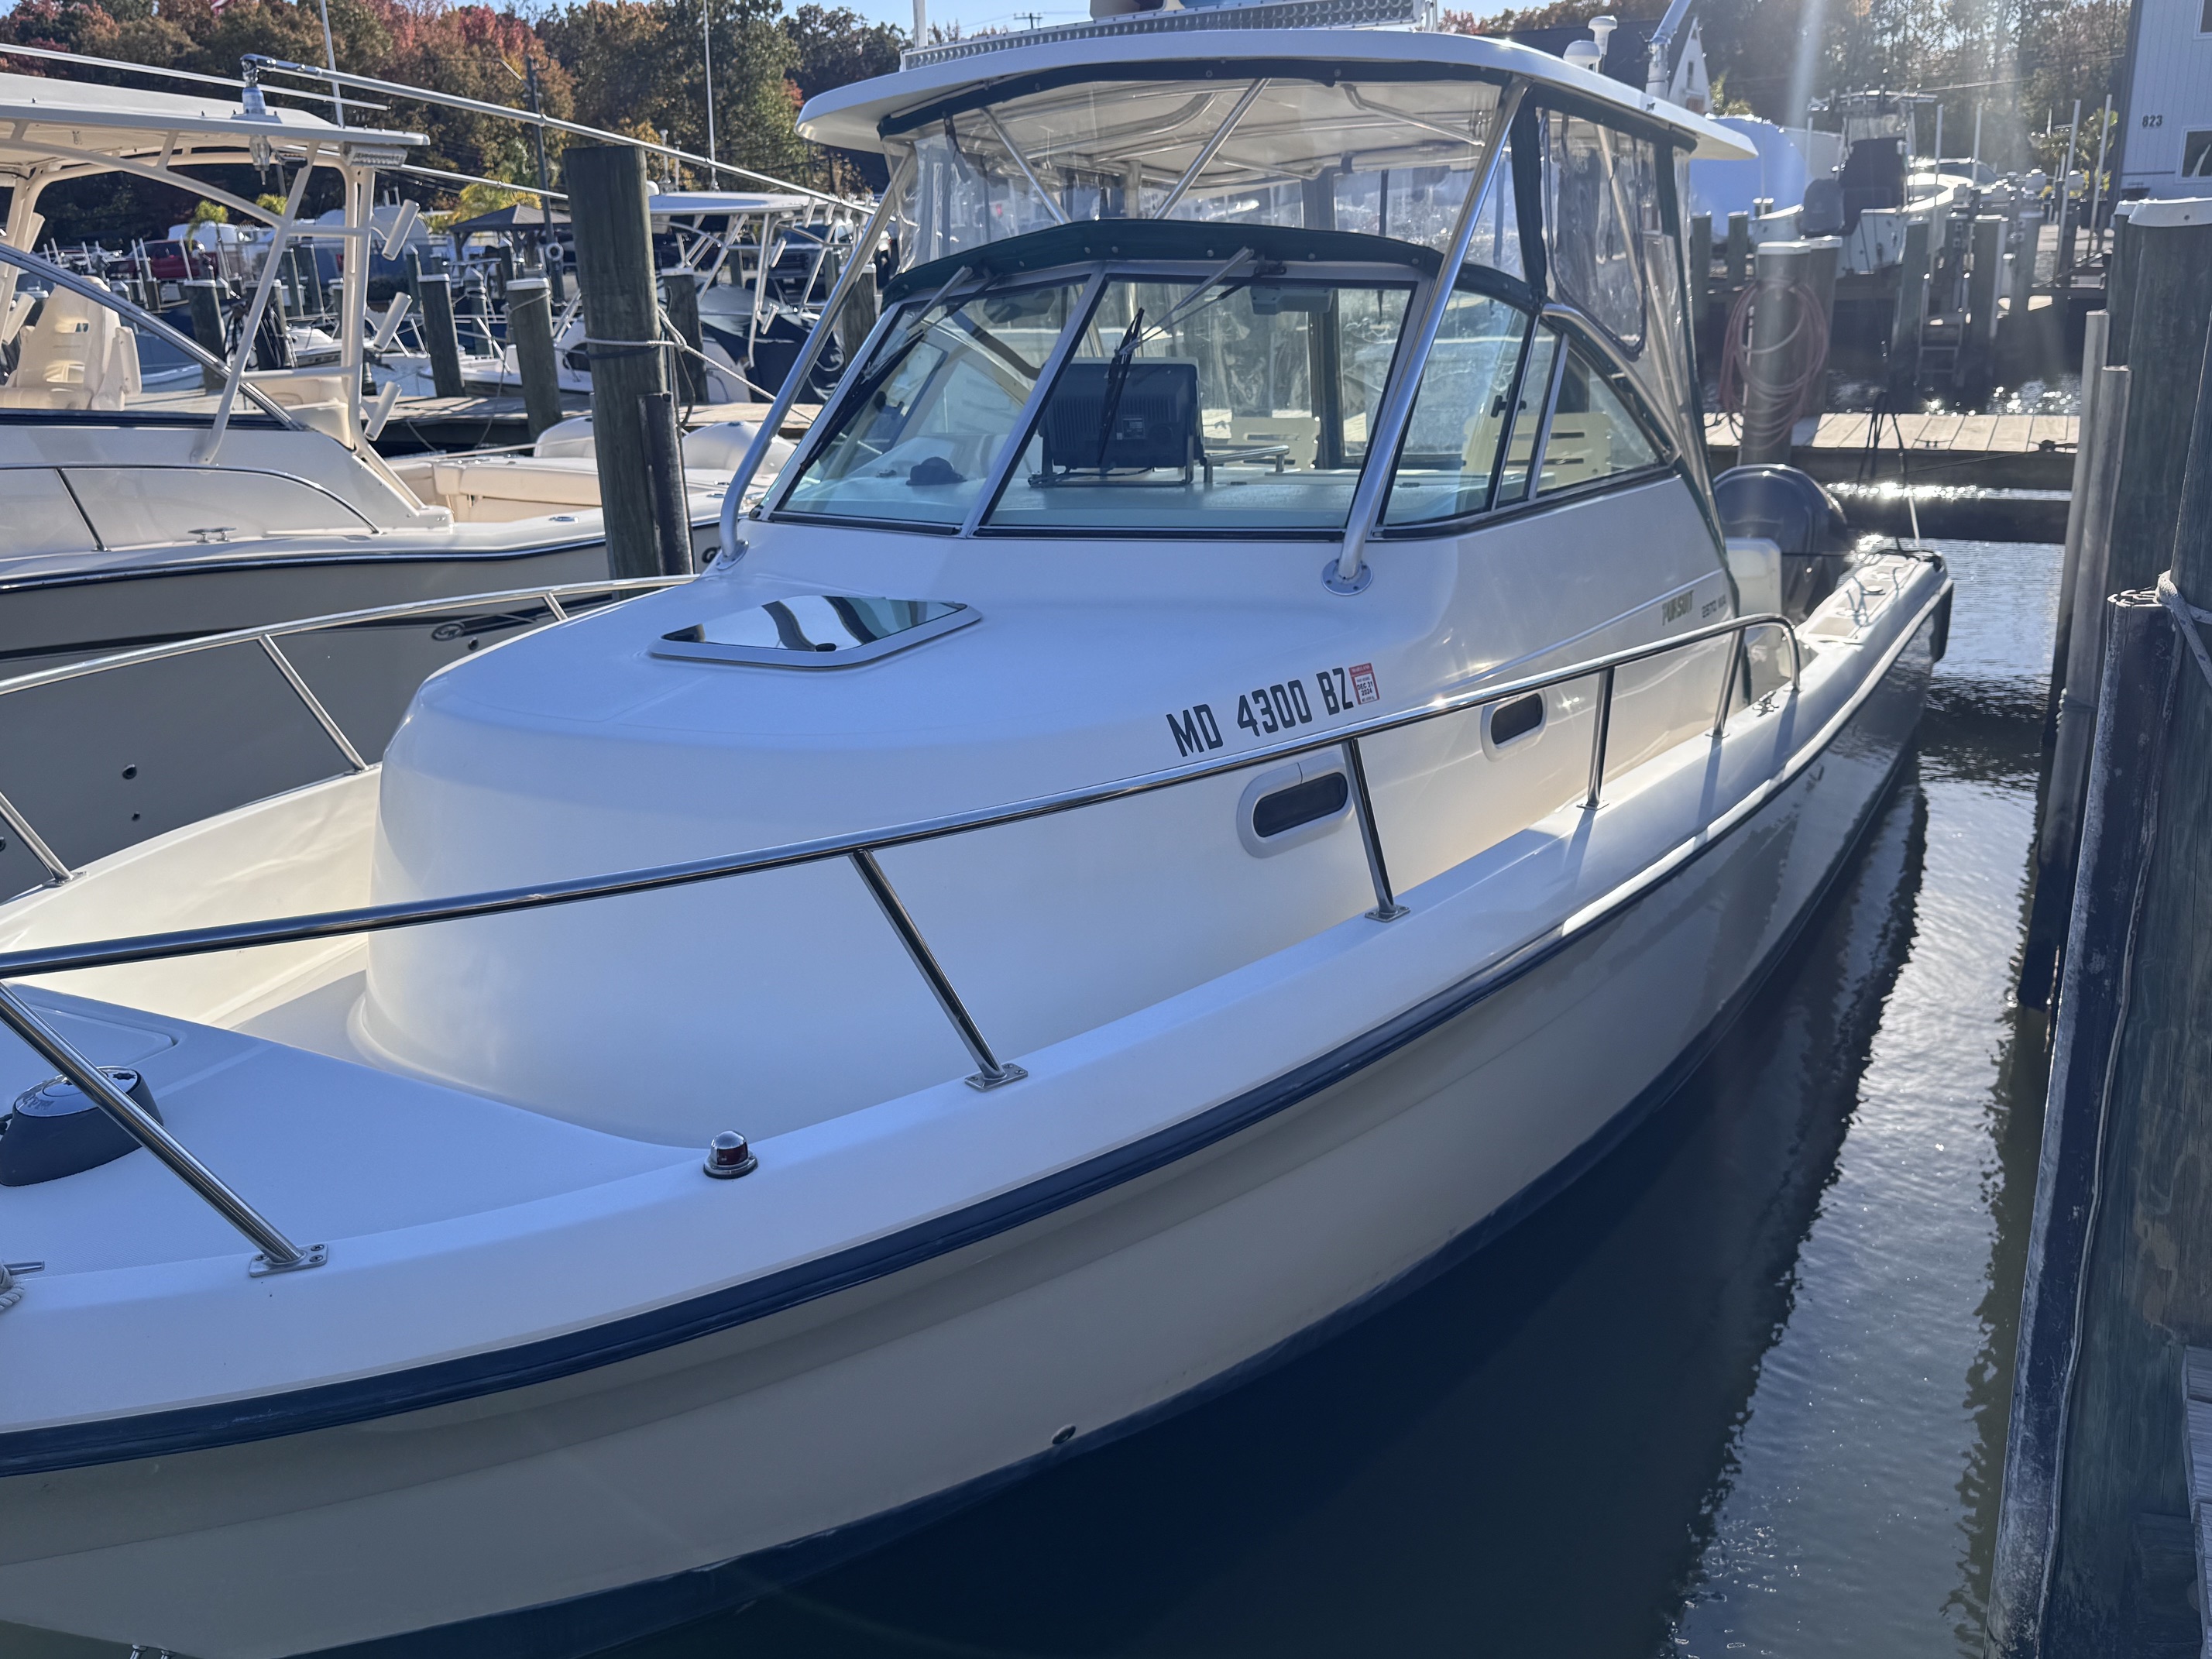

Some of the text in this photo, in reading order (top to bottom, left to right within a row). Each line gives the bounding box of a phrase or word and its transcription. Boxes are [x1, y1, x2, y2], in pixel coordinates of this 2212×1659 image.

[2142, 115, 2162, 128] 823
[1361, 688, 1372, 696] 2024
[1166, 667, 1354, 757] MD 4300 BZ
